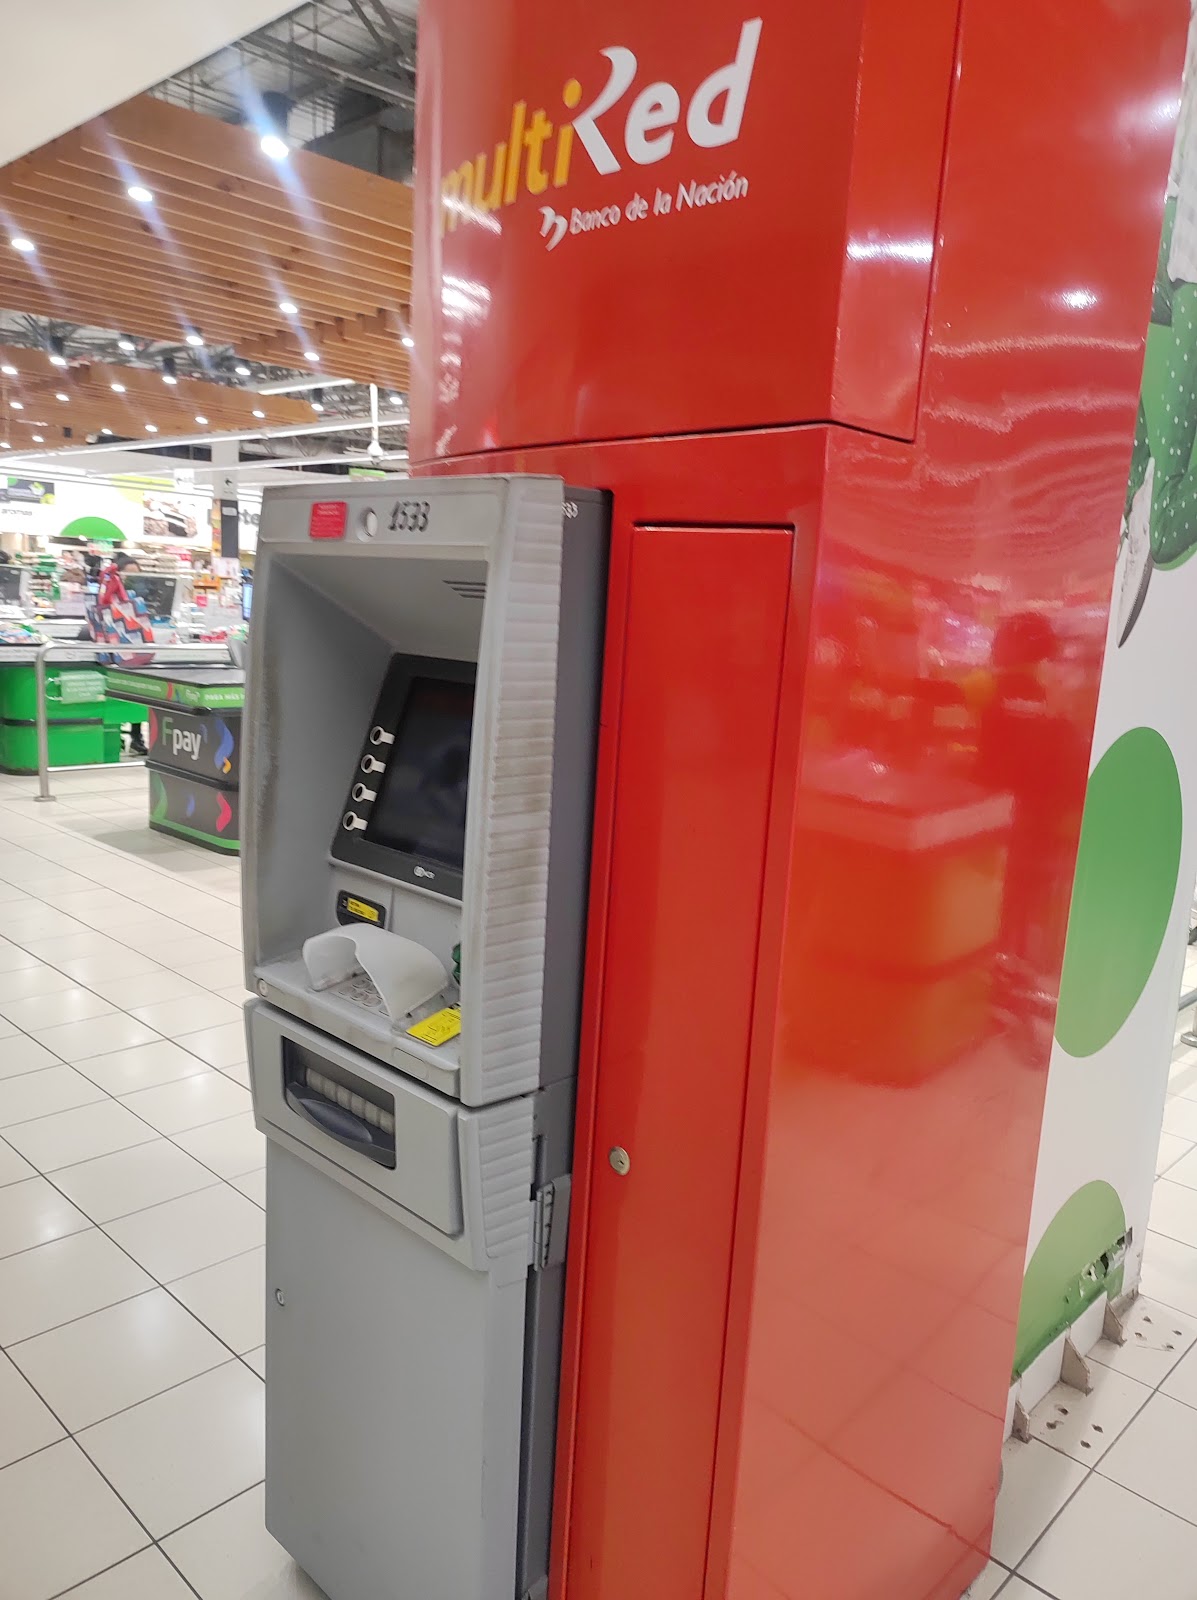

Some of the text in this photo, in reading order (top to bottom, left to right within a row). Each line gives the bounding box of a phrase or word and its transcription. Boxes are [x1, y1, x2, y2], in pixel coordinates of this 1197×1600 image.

[569, 171, 749, 235] Banco de la Nación
[388, 501, 431, 532] 1533
[162, 716, 202, 761] Fpay
